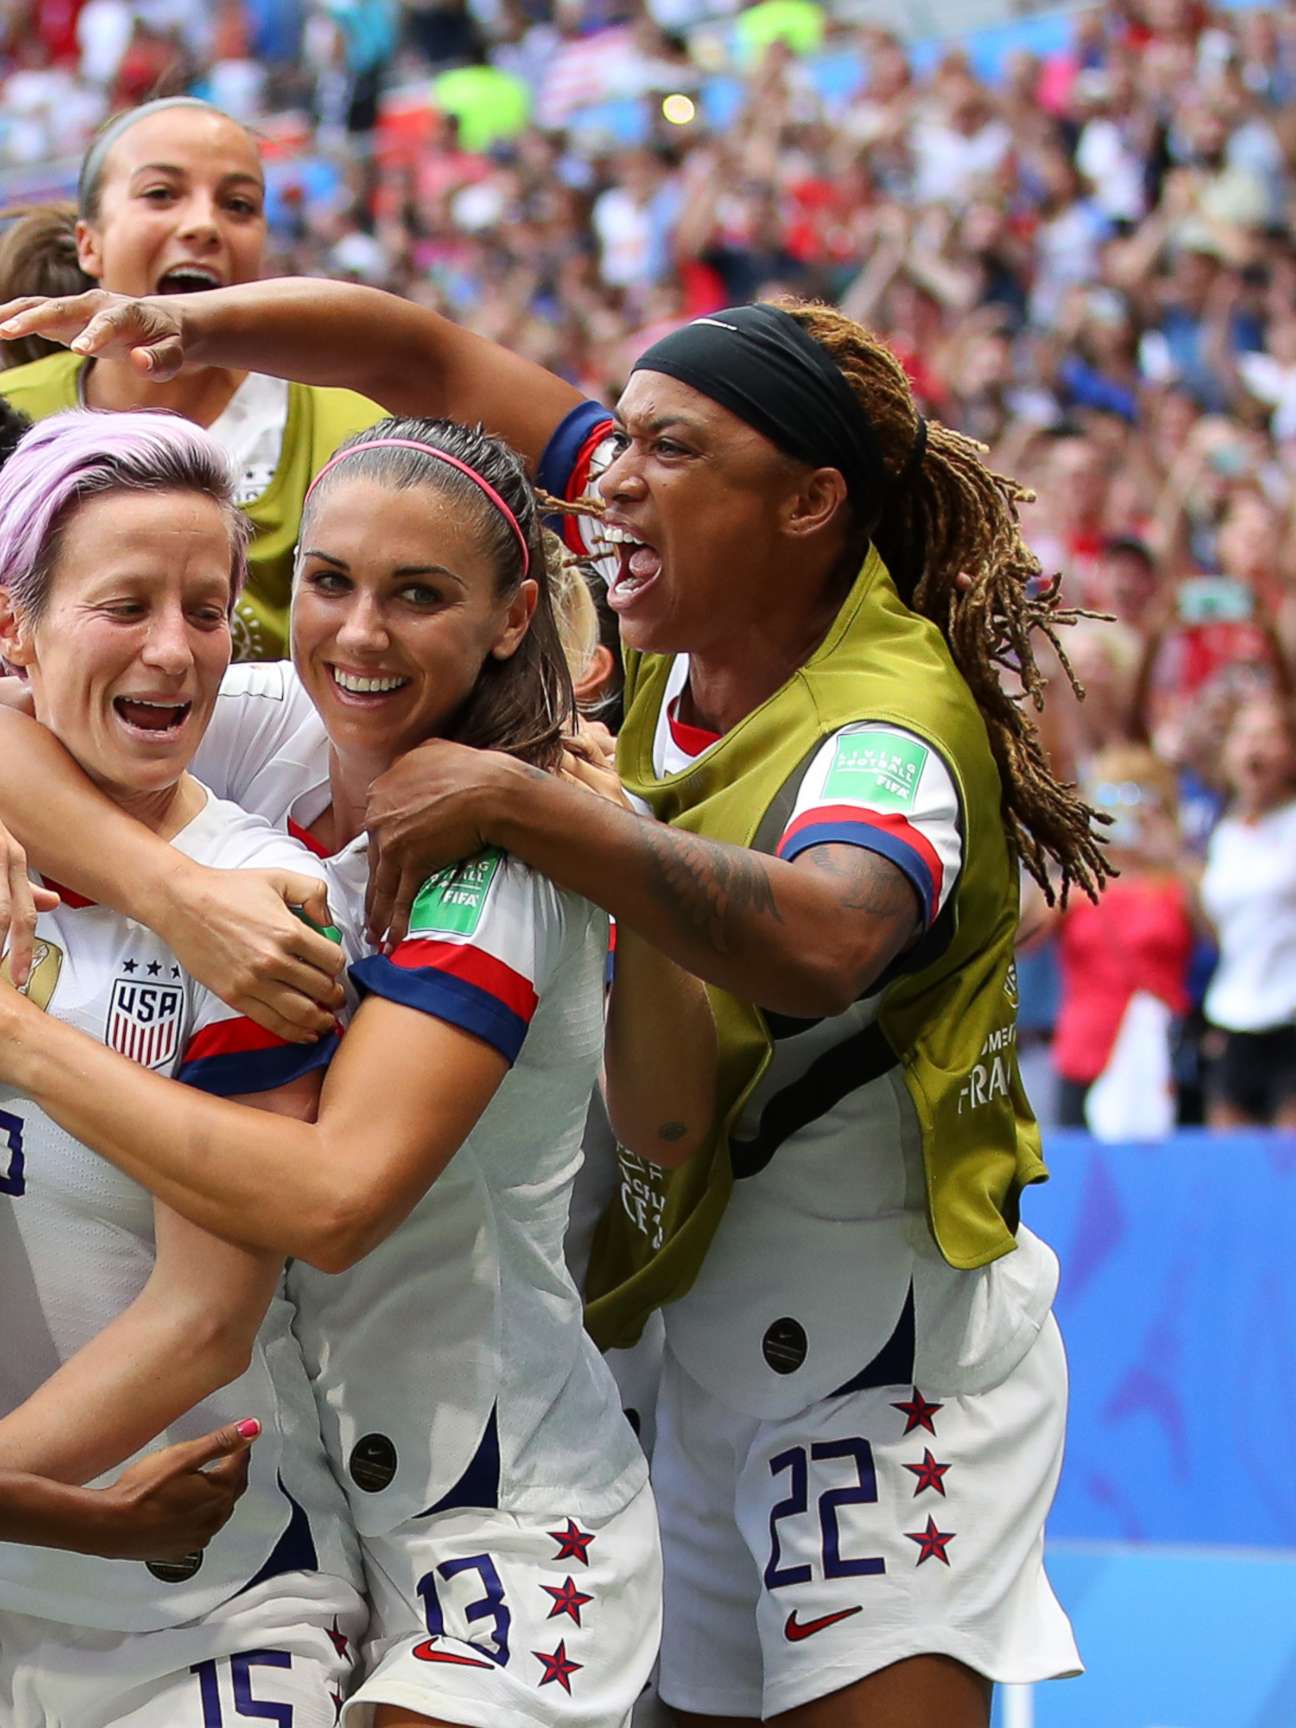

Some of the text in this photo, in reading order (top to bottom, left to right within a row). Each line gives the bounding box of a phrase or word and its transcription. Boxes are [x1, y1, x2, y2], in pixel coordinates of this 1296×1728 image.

[876, 775, 911, 800] FIFA
[443, 890, 477, 908] FIFA
[117, 986, 178, 1023] USA
[764, 1437, 886, 1591] 22
[416, 1552, 511, 1668] 13
[189, 1648, 293, 1728] 15
